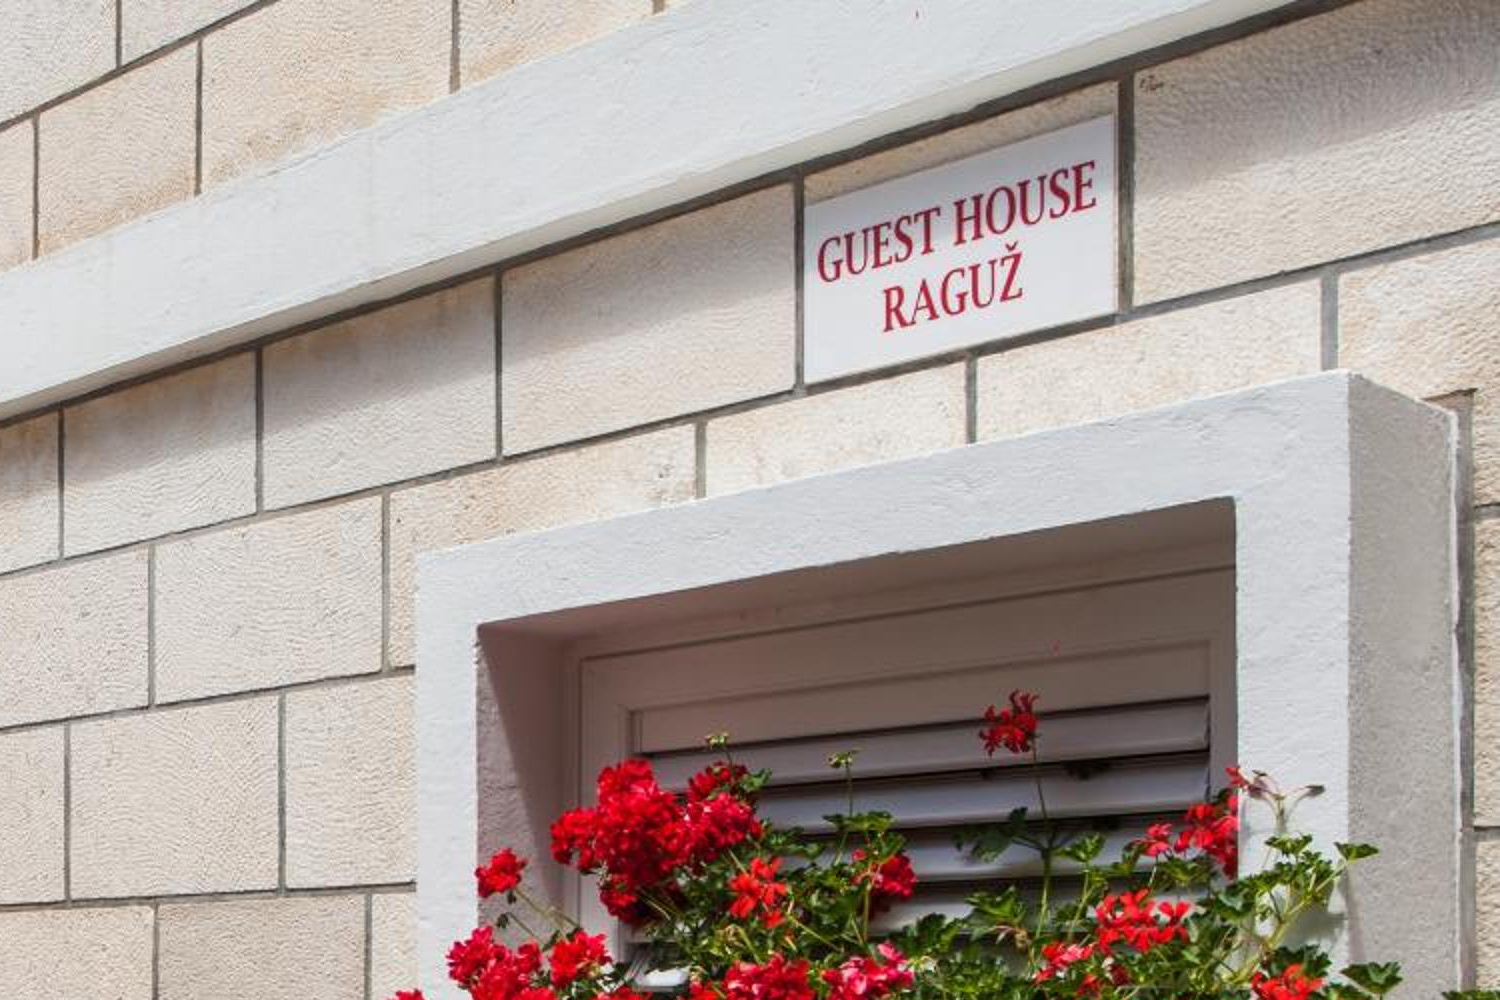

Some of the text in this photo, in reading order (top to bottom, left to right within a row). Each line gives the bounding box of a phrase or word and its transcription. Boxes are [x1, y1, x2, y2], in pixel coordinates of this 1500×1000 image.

[817, 160, 1097, 283] GUEST HOUSE
[883, 241, 1023, 332] RAGUŽ
